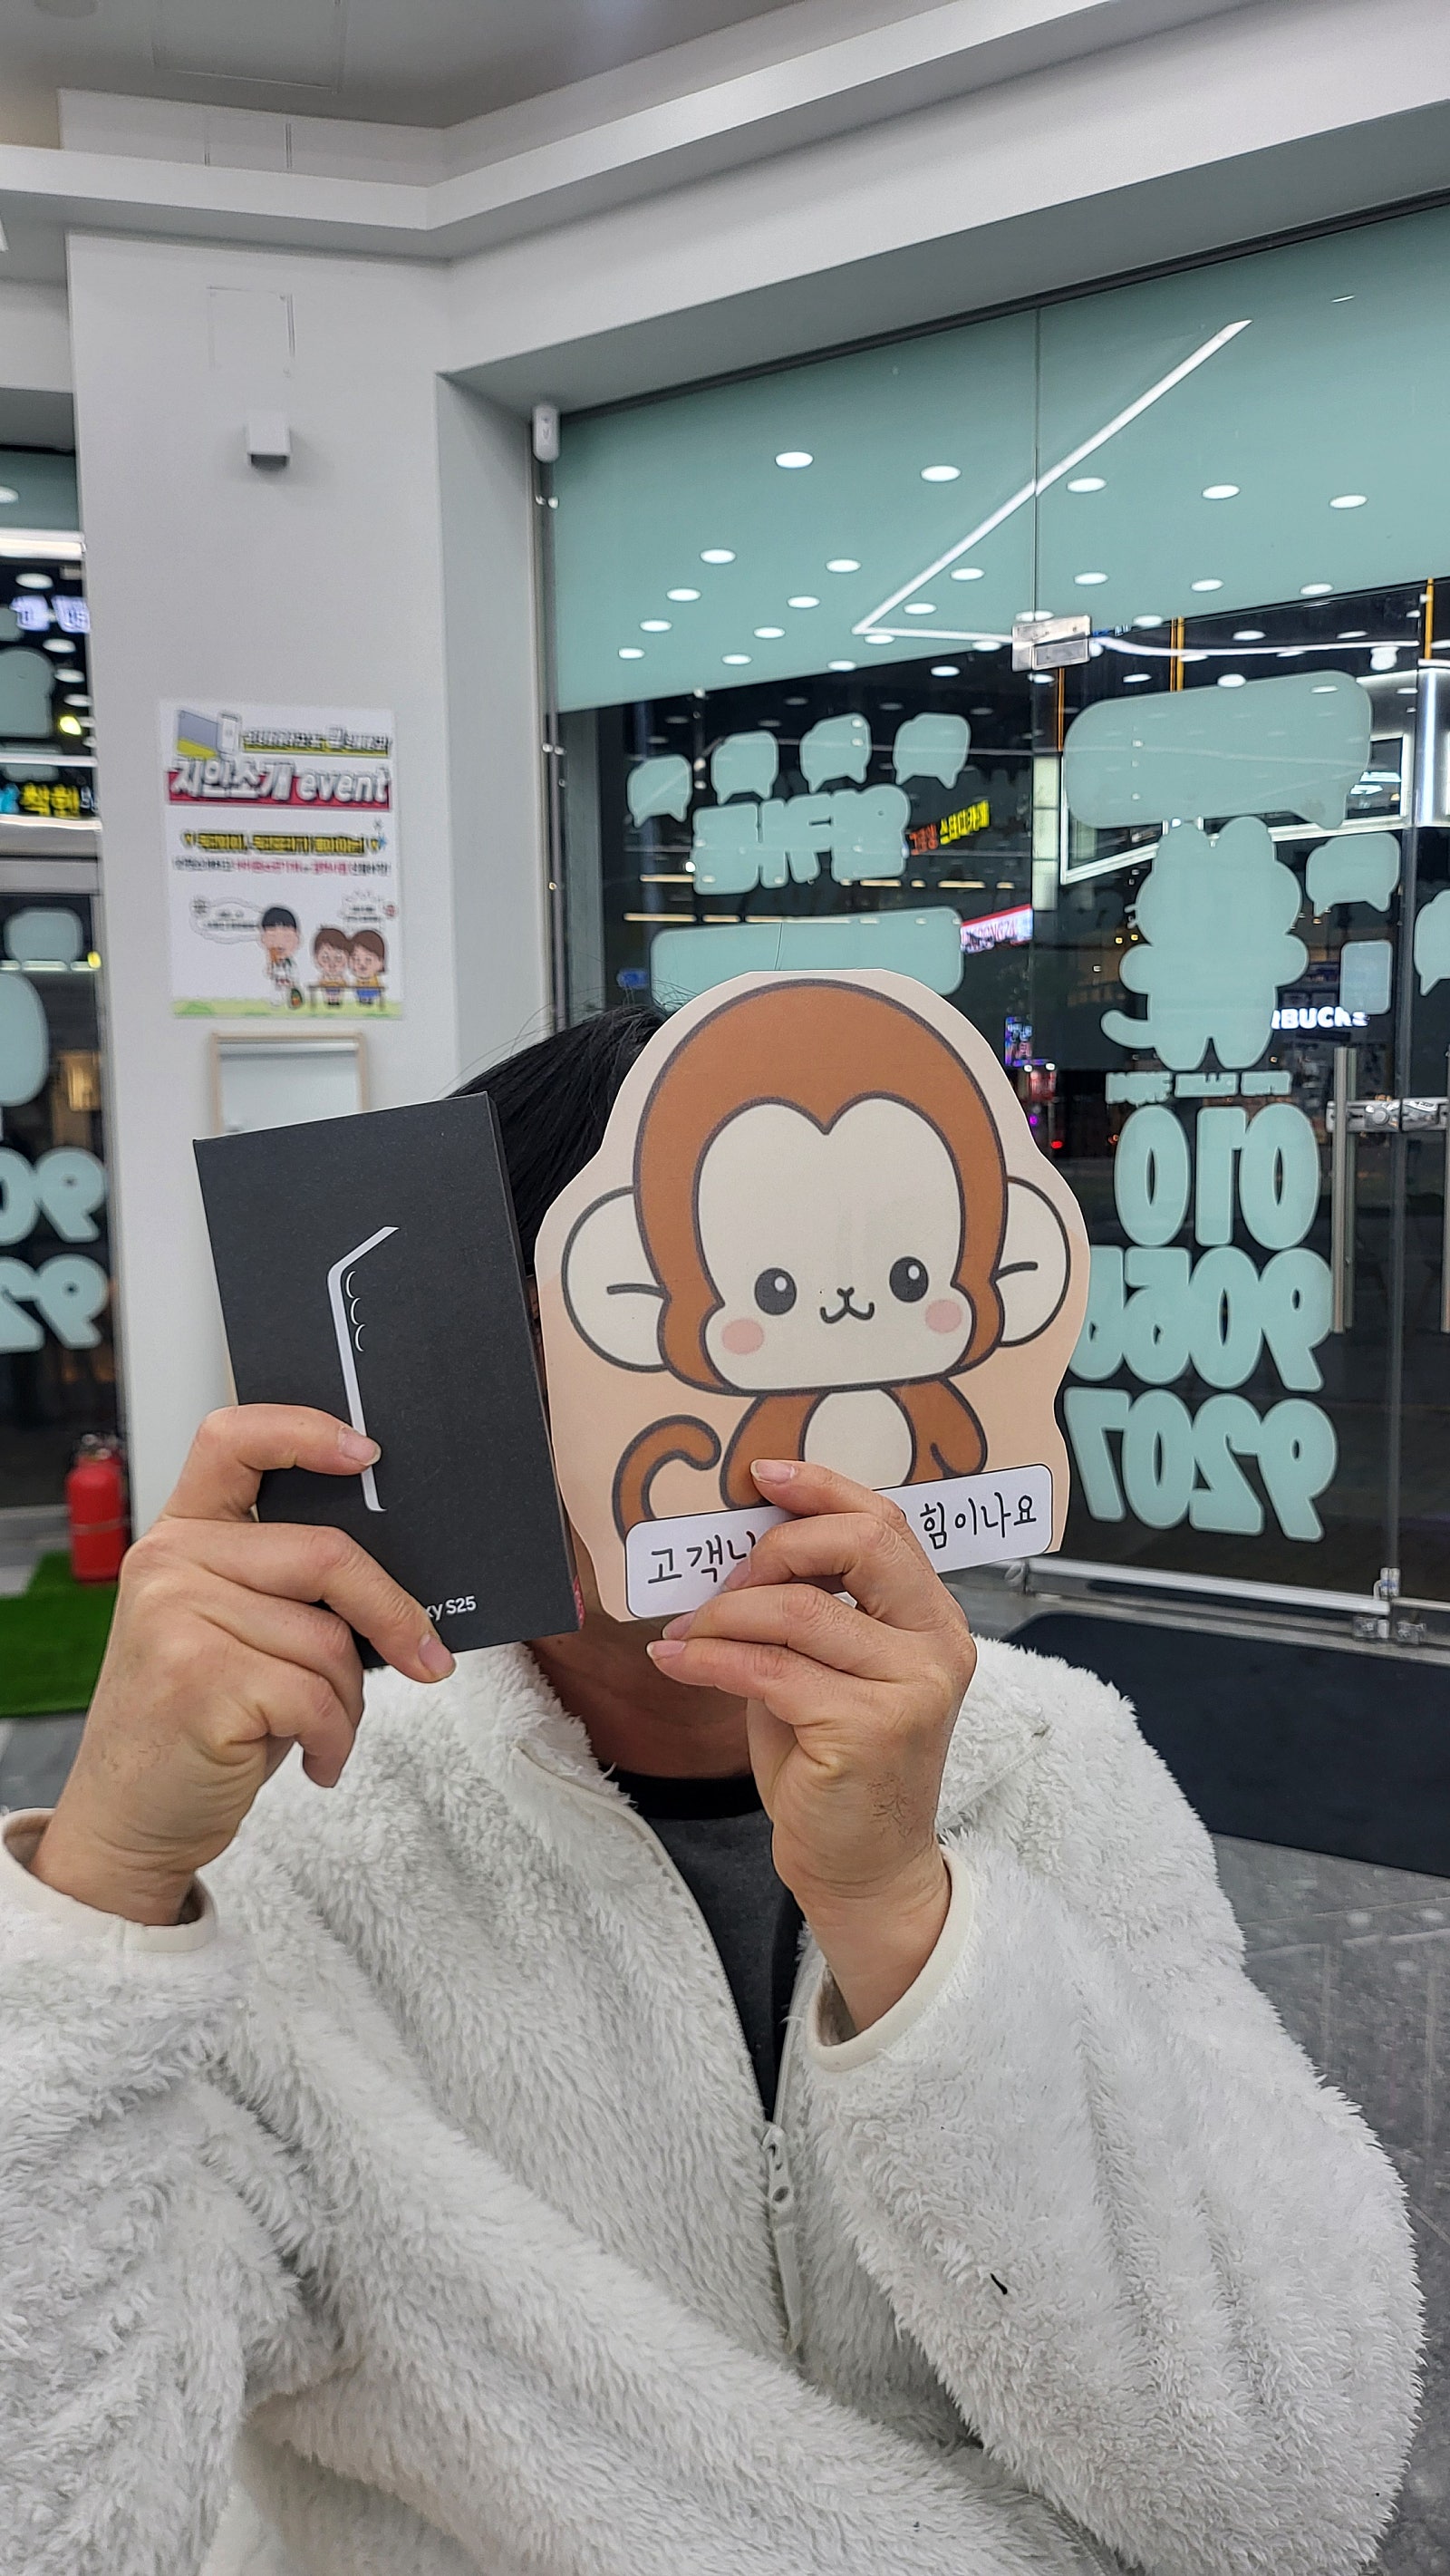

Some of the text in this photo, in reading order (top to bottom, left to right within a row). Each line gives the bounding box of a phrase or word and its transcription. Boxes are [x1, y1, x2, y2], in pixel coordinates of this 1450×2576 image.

[170, 759, 390, 803] 지인소개 event
[920, 1491, 1037, 1550] 힘이나요
[445, 1595, 477, 1615] S25
